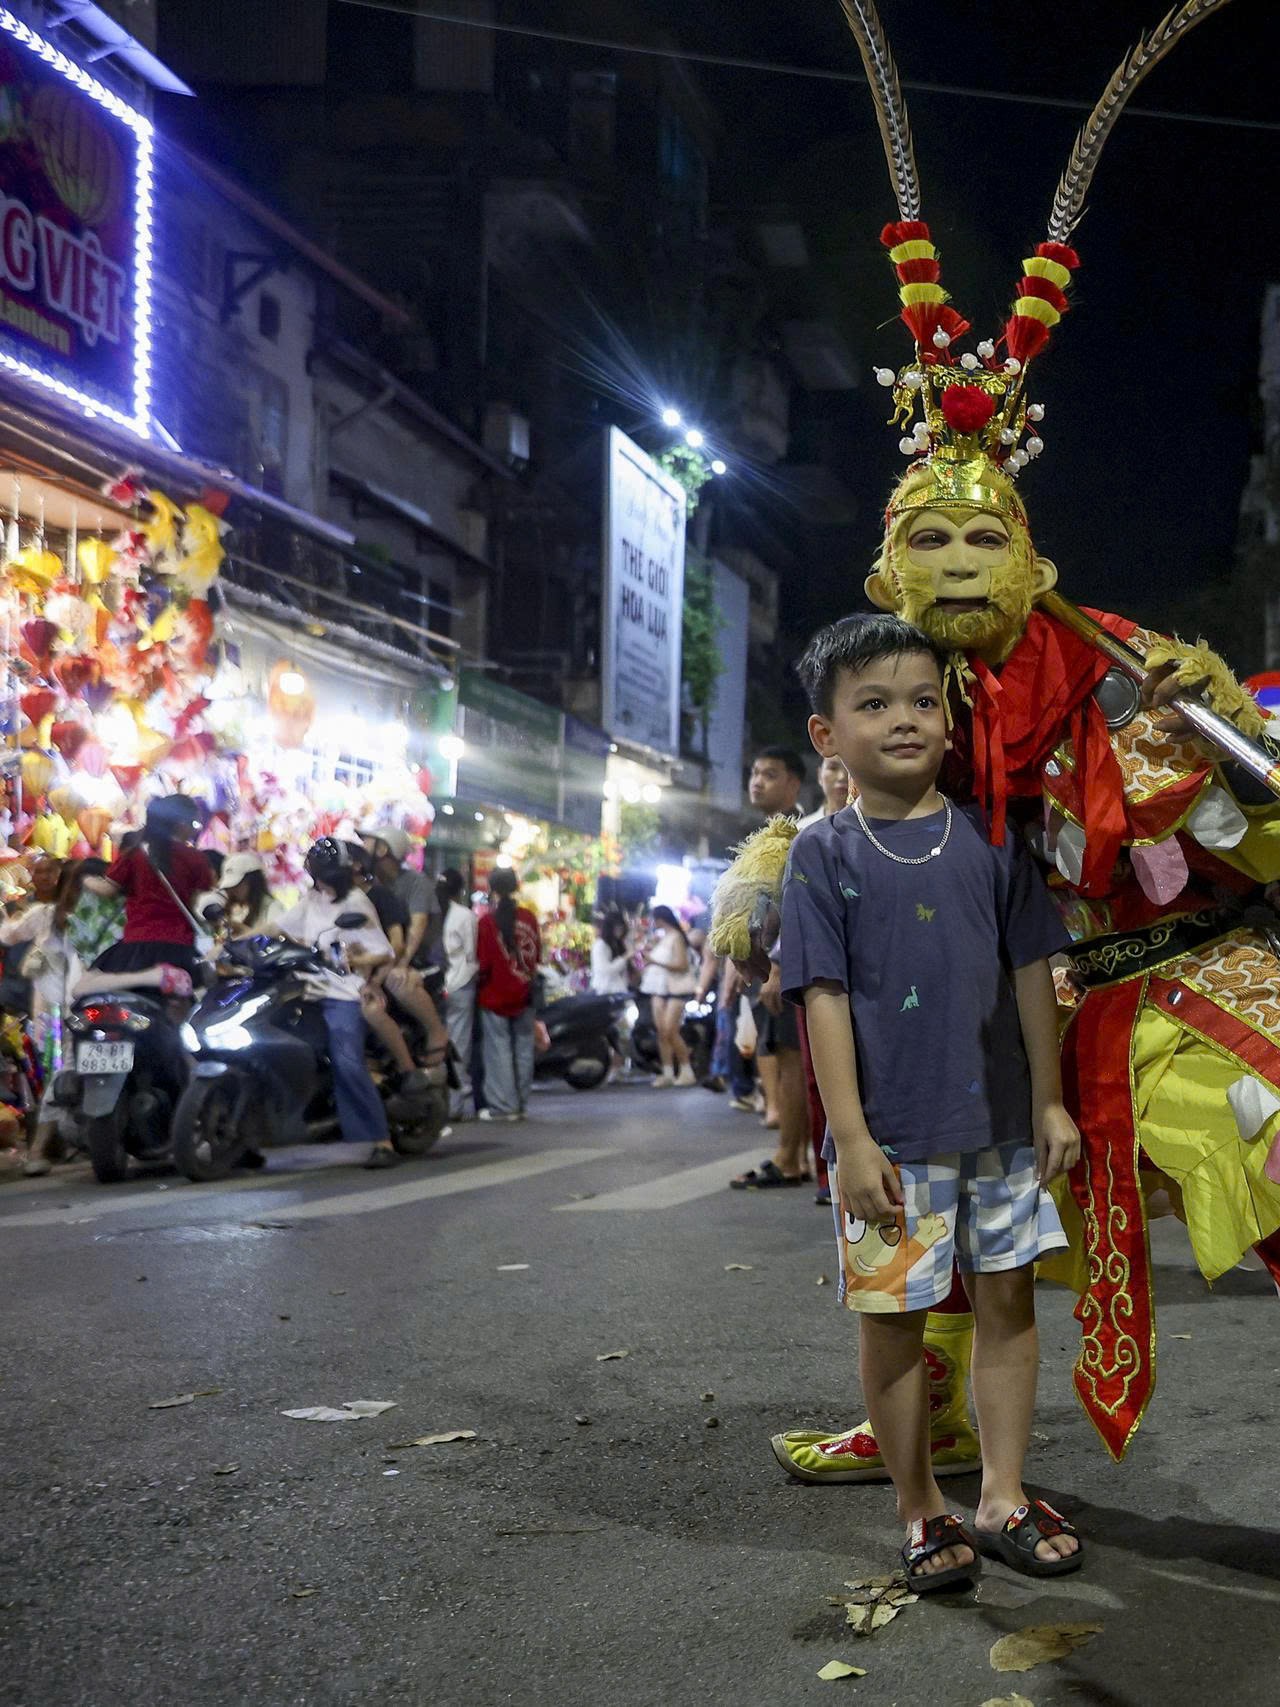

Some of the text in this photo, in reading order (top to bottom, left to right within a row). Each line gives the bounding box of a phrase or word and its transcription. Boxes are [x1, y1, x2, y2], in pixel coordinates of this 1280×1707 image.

[0, 193, 126, 347] G VIỆT
[622, 583, 644, 628] HOA
